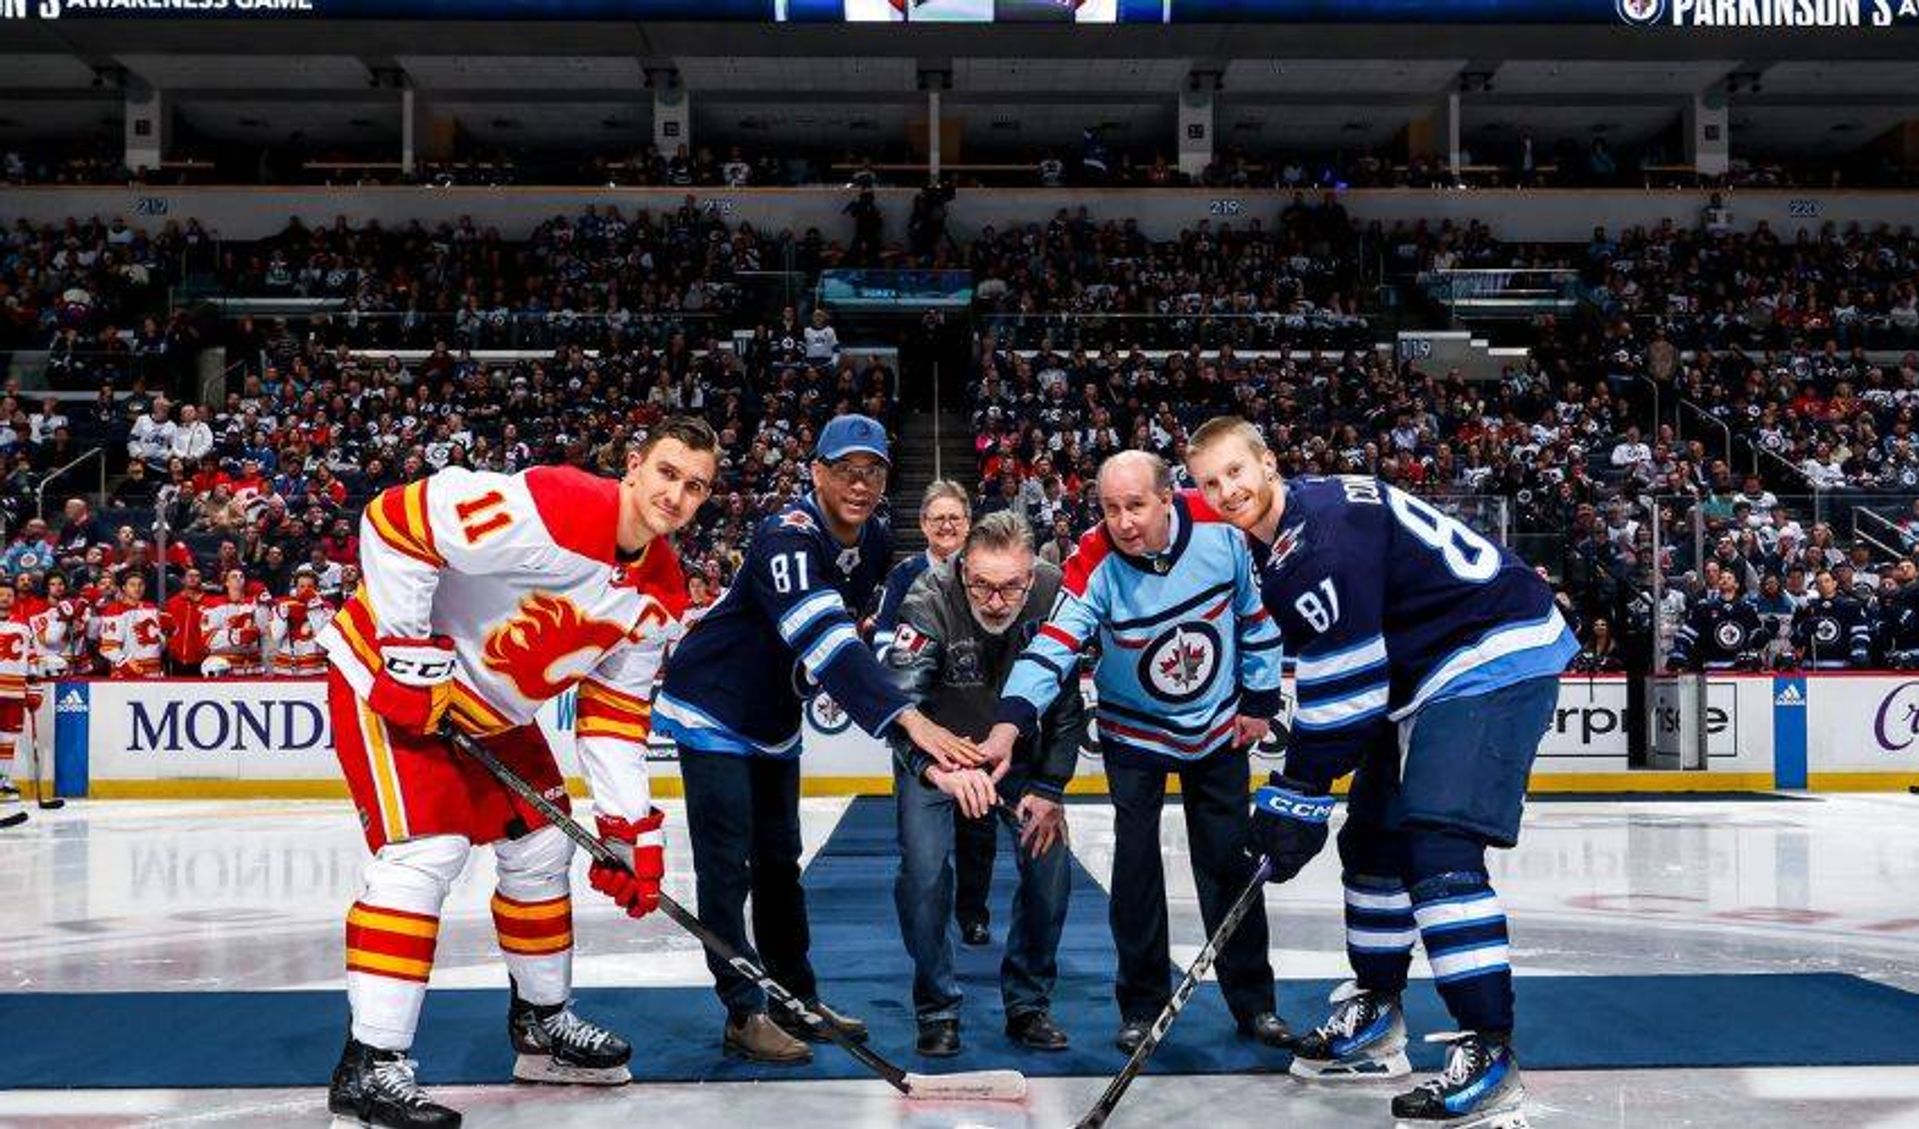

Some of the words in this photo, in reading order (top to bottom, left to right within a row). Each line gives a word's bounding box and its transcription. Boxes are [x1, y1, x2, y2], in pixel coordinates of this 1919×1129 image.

[1672, 0, 1892, 26] PARKINSONS
[455, 489, 514, 545] 11
[769, 551, 811, 594] 81
[1294, 576, 1341, 634] 81
[1269, 795, 1332, 817] CCM
